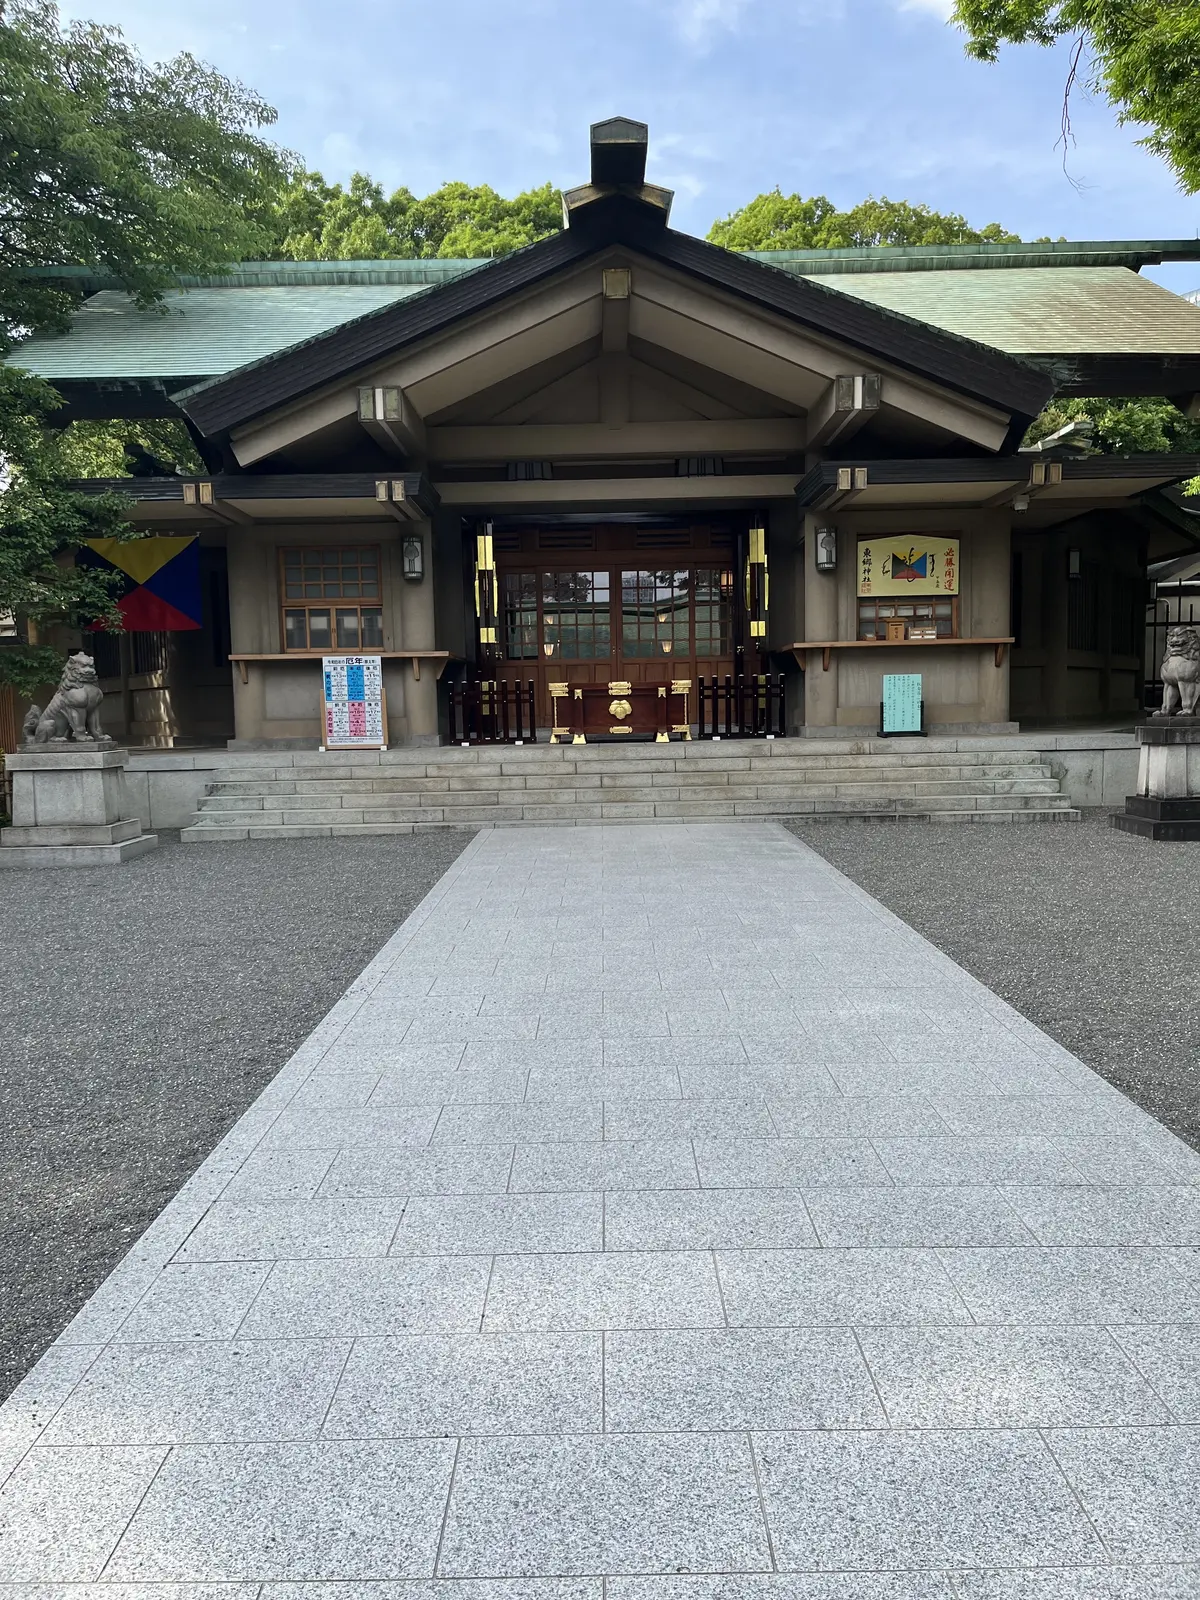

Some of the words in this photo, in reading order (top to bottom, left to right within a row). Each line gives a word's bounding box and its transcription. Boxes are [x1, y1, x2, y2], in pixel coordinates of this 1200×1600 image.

[861, 547, 873, 583] 東郷神社
[943, 547, 956, 592] 必勝開運
[345, 657, 363, 665] 厄年
